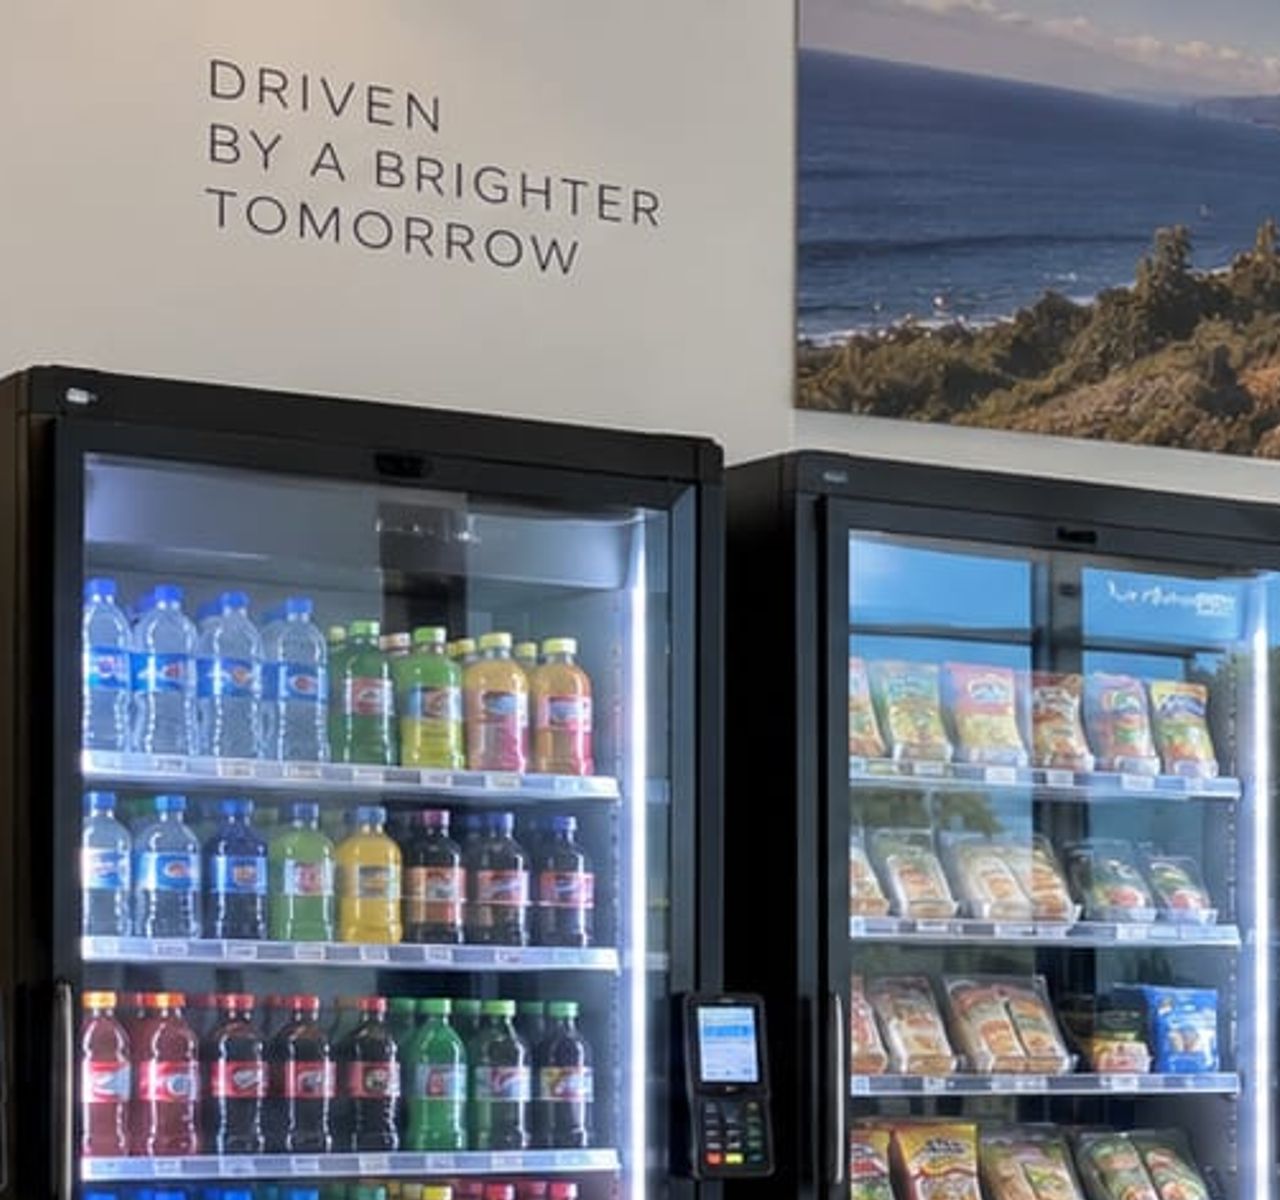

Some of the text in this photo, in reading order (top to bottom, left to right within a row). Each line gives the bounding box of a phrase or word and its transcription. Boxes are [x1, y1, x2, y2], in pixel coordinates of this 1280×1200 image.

[208, 58, 440, 134] DRIVEN
[208, 122, 660, 228] BY A BRIGHTER
[204, 187, 580, 276] TOMORROW
